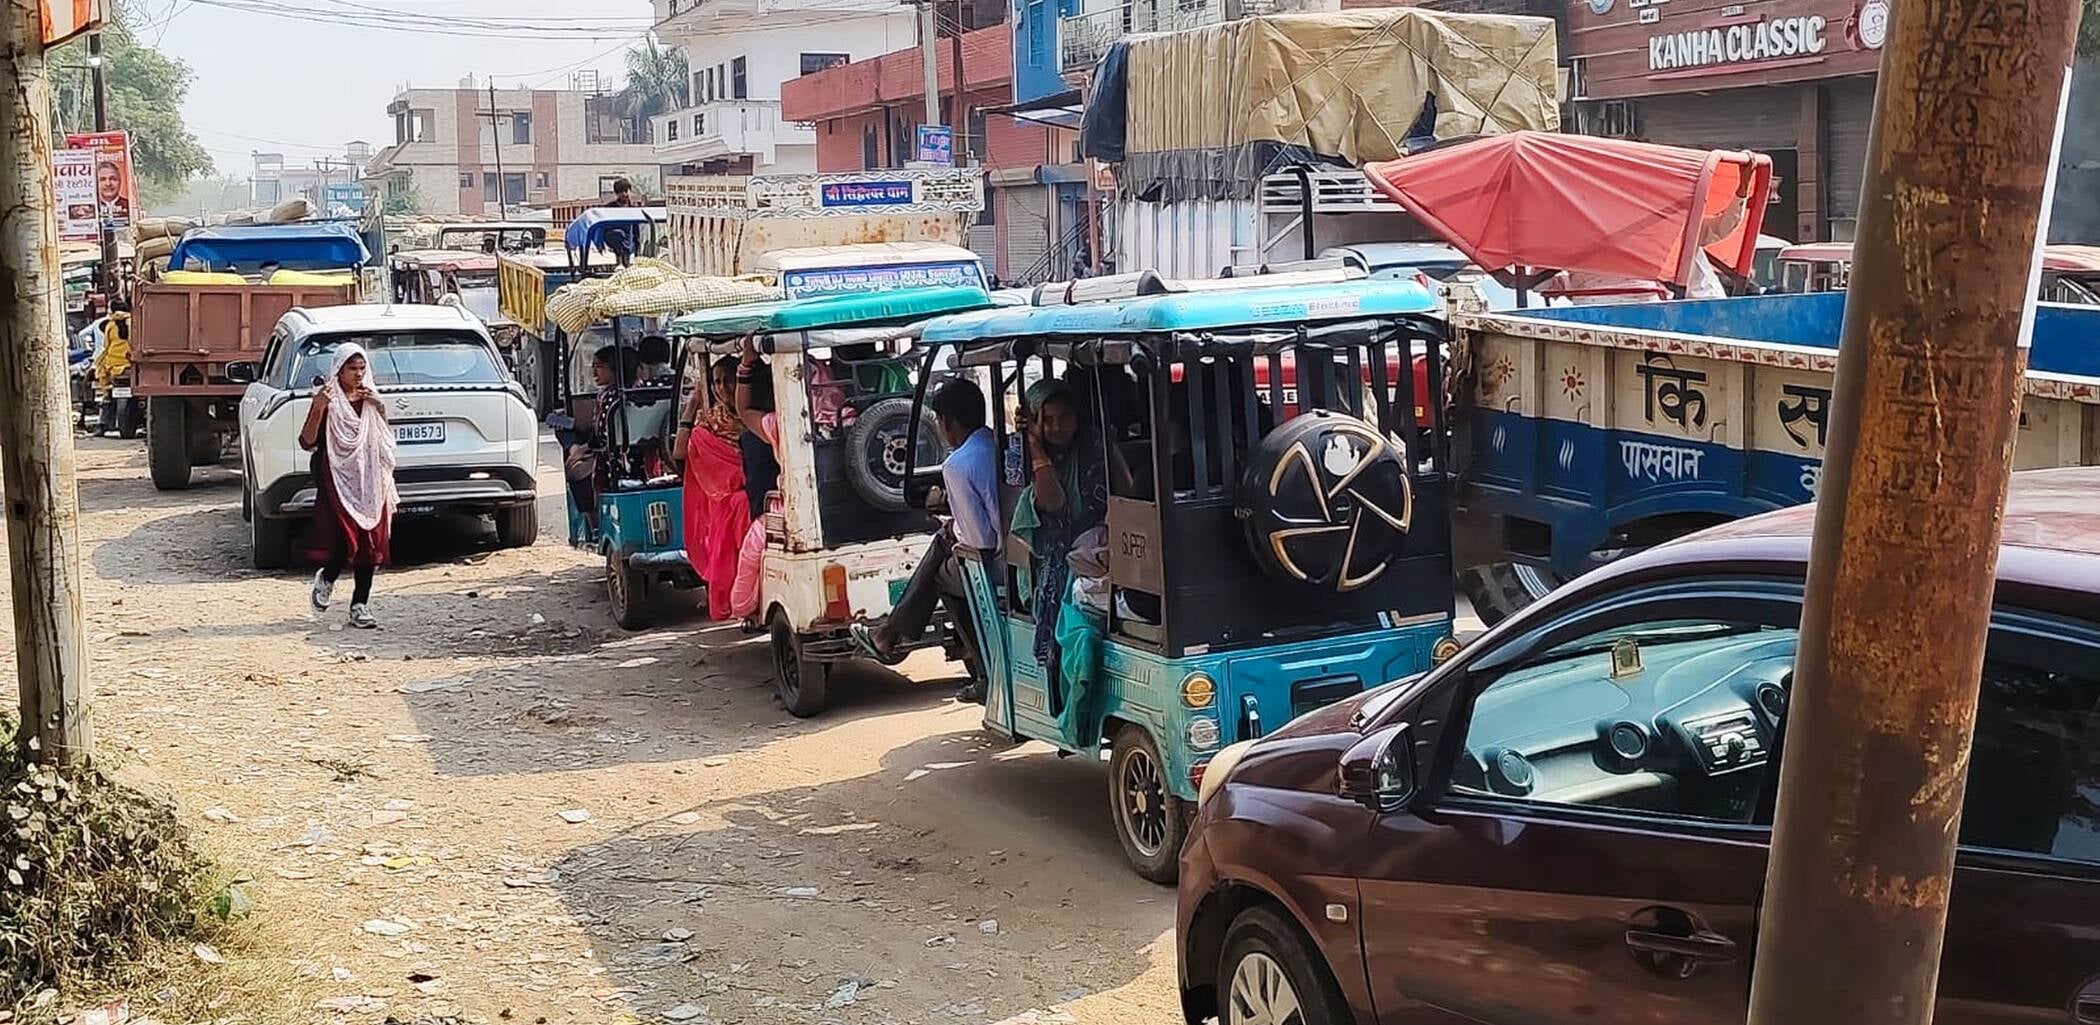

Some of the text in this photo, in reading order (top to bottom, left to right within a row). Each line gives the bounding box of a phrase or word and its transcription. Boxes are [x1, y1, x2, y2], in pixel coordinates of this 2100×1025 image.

[1649, 15, 1825, 70] KANHA CLASSIC
[393, 426, 442, 440] 1BN8573
[1619, 440, 1705, 484] पासवान
[1121, 531, 1147, 560] SUPER
